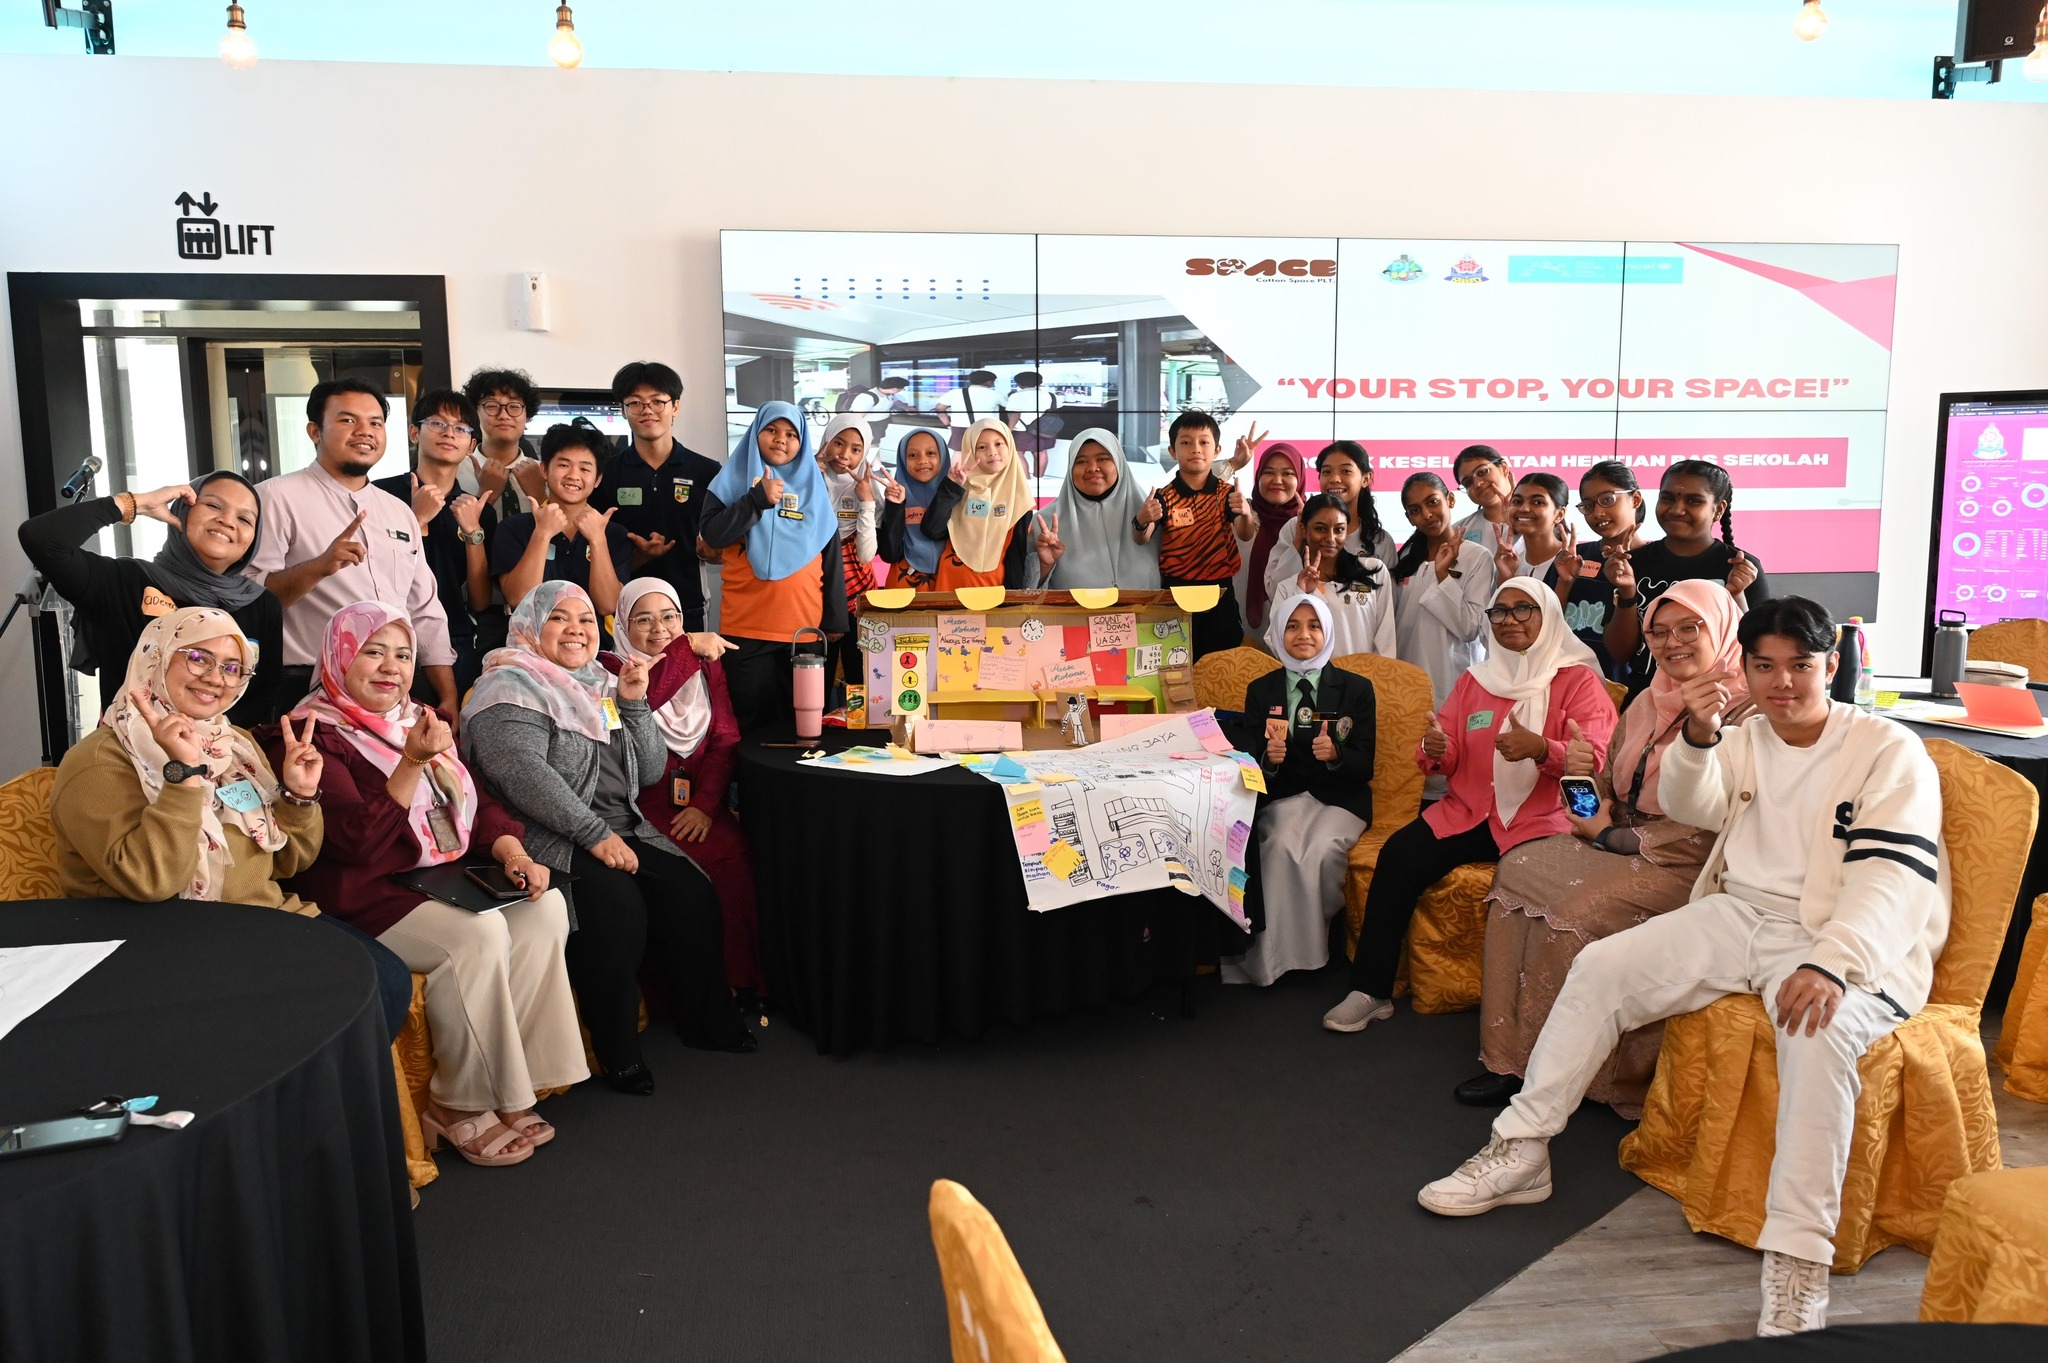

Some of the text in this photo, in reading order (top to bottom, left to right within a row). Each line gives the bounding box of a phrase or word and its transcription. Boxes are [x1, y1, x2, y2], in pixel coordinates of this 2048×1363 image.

[224, 224, 275, 256] LIFT
[1288, 277, 1315, 285] Space
[1428, 378, 1549, 402] STOP,
[1560, 378, 1674, 399] YOUR
[1723, 454, 1829, 466] SEKOLAH
[1093, 614, 1121, 624] COUNT
[1106, 623, 1130, 631] DOWN
[1096, 635, 1121, 645] UASA
[1142, 732, 1177, 749] JAYA
[1096, 880, 1121, 893] Pagar
